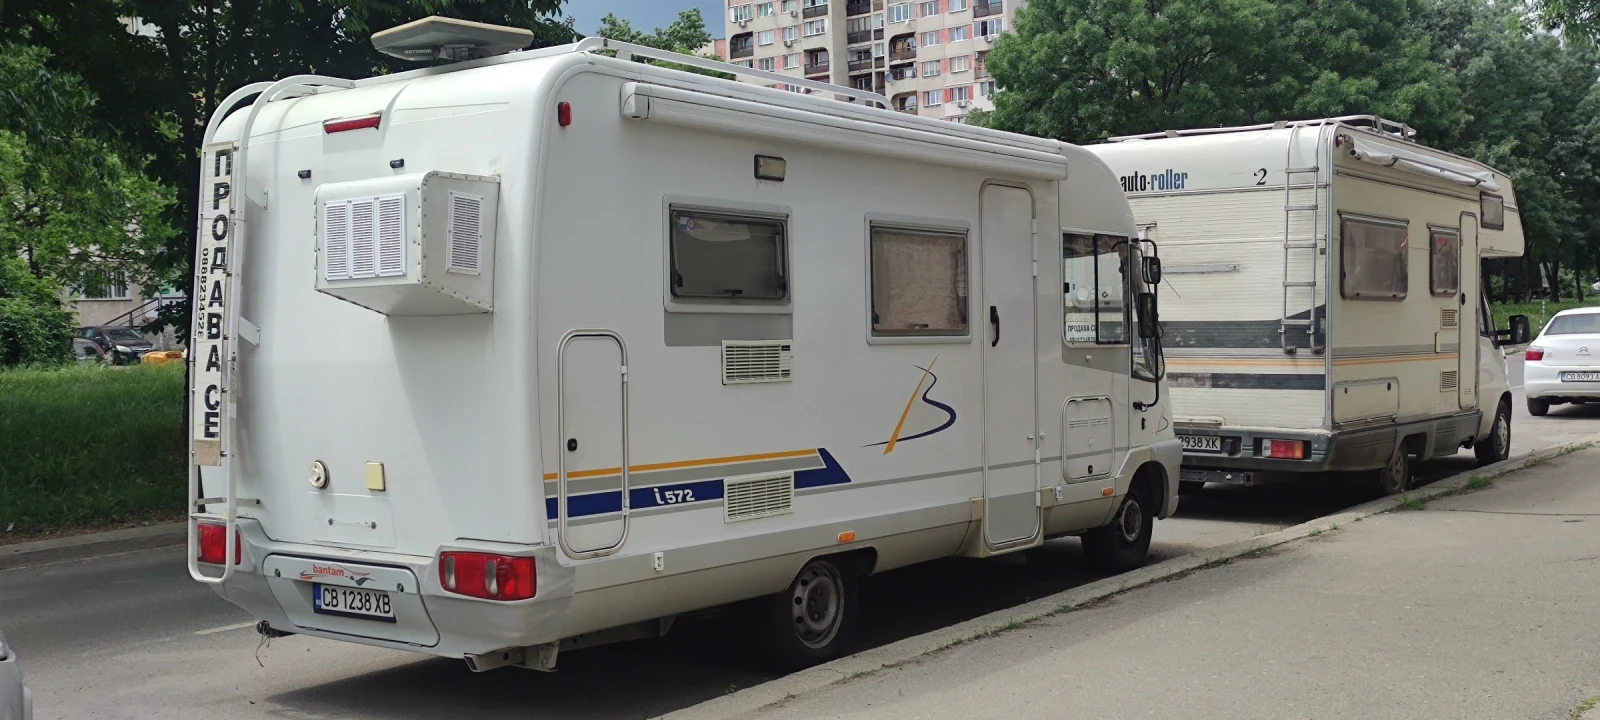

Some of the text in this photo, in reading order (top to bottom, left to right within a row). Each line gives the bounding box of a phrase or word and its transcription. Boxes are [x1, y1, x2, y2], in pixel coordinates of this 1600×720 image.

[203, 148, 232, 439] ПРОДАВА СЕ
[1178, 436, 1203, 448] 2938
[664, 488, 696, 504] 572
[312, 564, 345, 577] bantam
[342, 589, 372, 612] 1238
